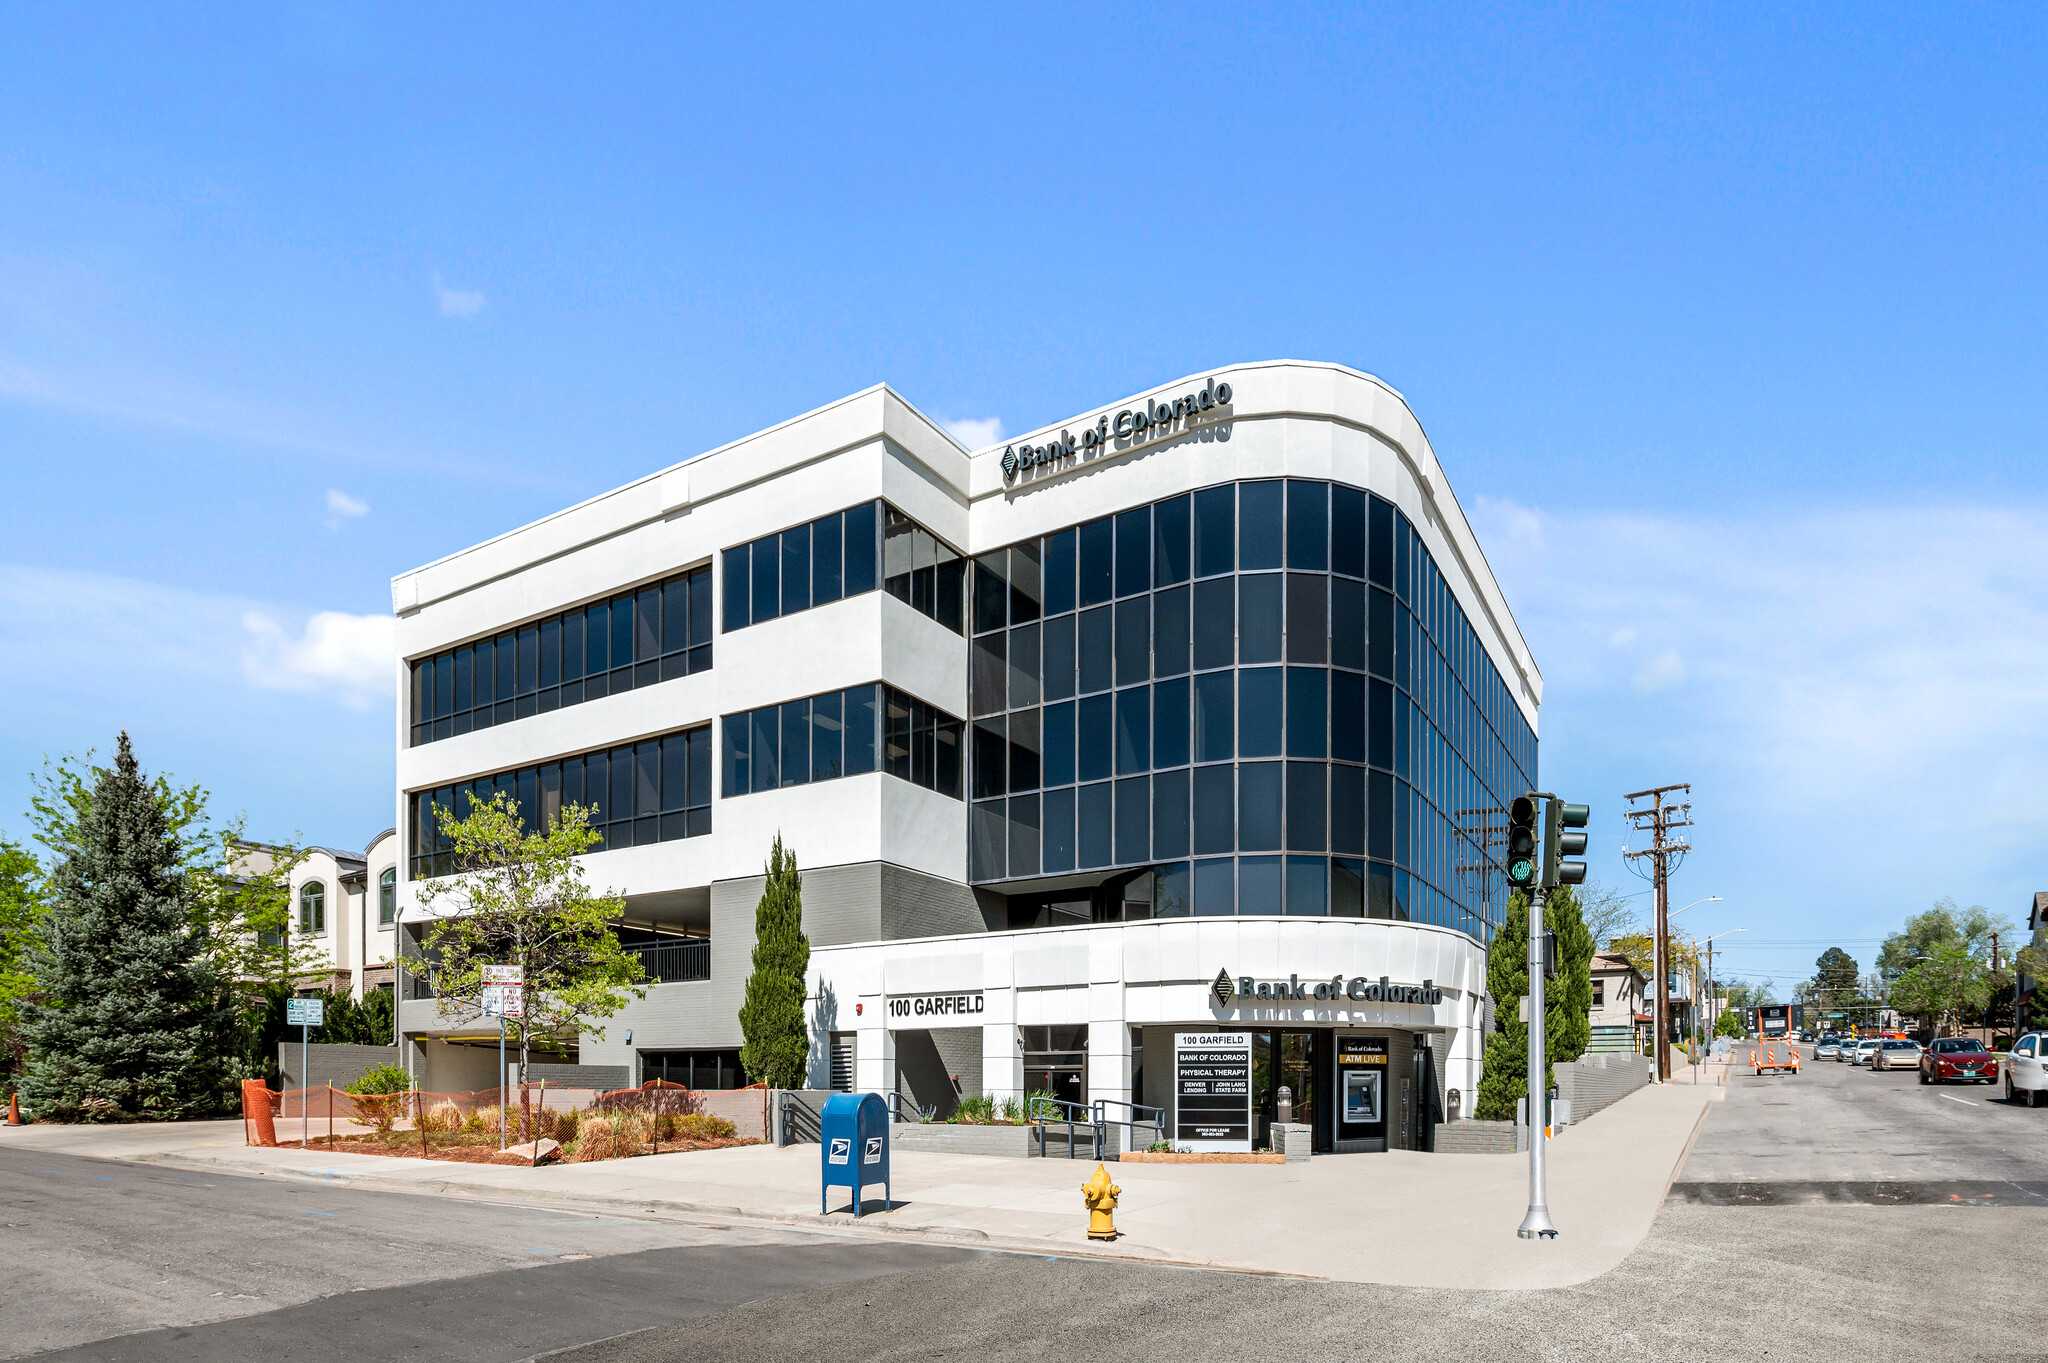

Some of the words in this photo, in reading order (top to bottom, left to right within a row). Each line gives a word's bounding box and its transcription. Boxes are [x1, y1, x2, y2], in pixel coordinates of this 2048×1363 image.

[1019, 429, 1076, 471] Bank
[1082, 415, 1109, 449] of
[1113, 377, 1233, 438] Colorado
[1238, 974, 1306, 1001] Bank
[1313, 974, 1343, 1001] of
[1347, 976, 1443, 1005] Colorado
[888, 999, 910, 1017] 100
[914, 996, 984, 1016] GARFIELD
[1200, 1036, 1244, 1044] GARFIELD
